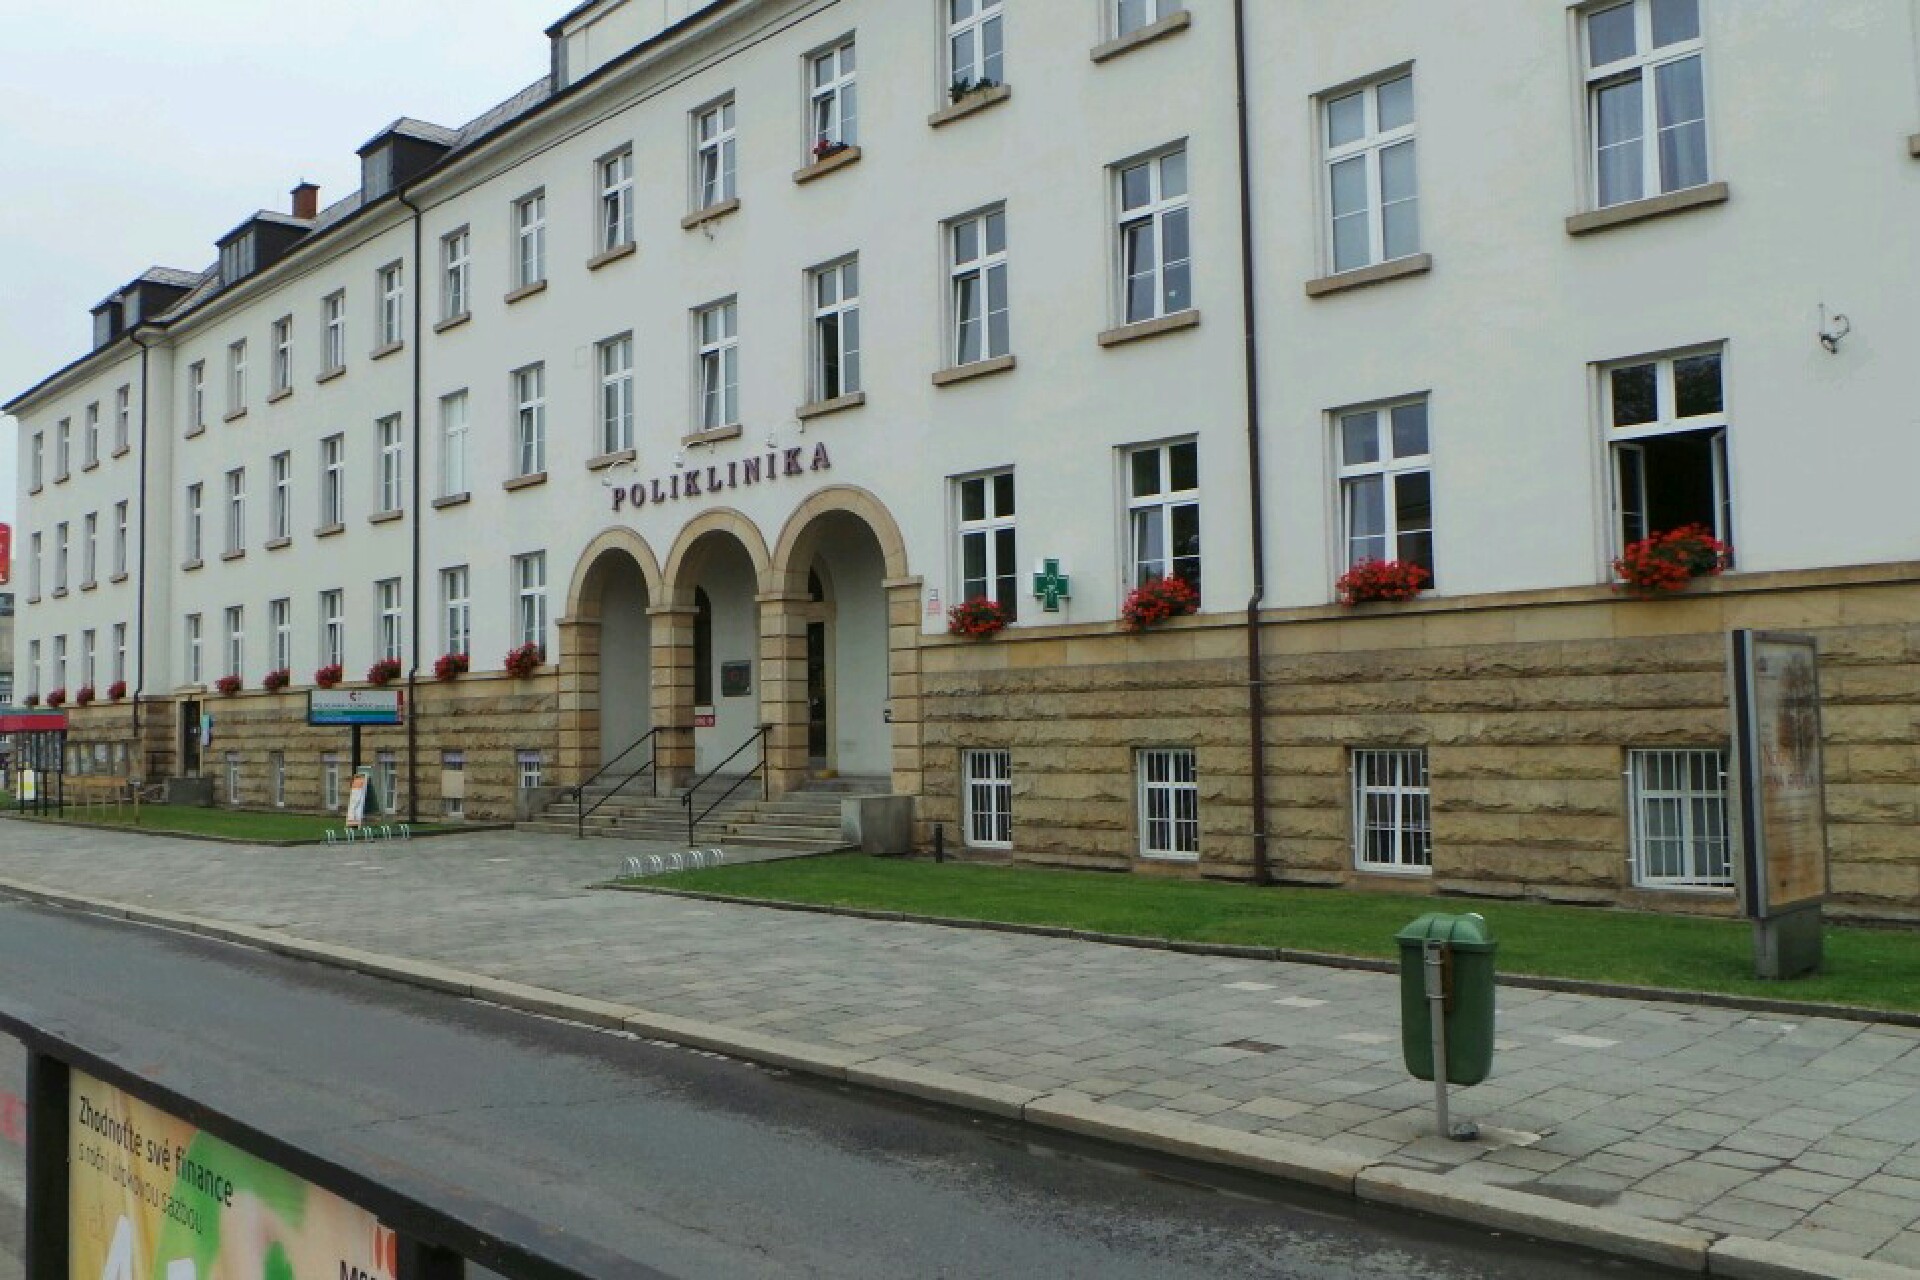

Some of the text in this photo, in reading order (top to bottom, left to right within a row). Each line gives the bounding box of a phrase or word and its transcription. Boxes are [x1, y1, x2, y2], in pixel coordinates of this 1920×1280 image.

[611, 441, 831, 512] POLIKLINIKA
[79, 1095, 233, 1208] Zhodnoťte své finance
